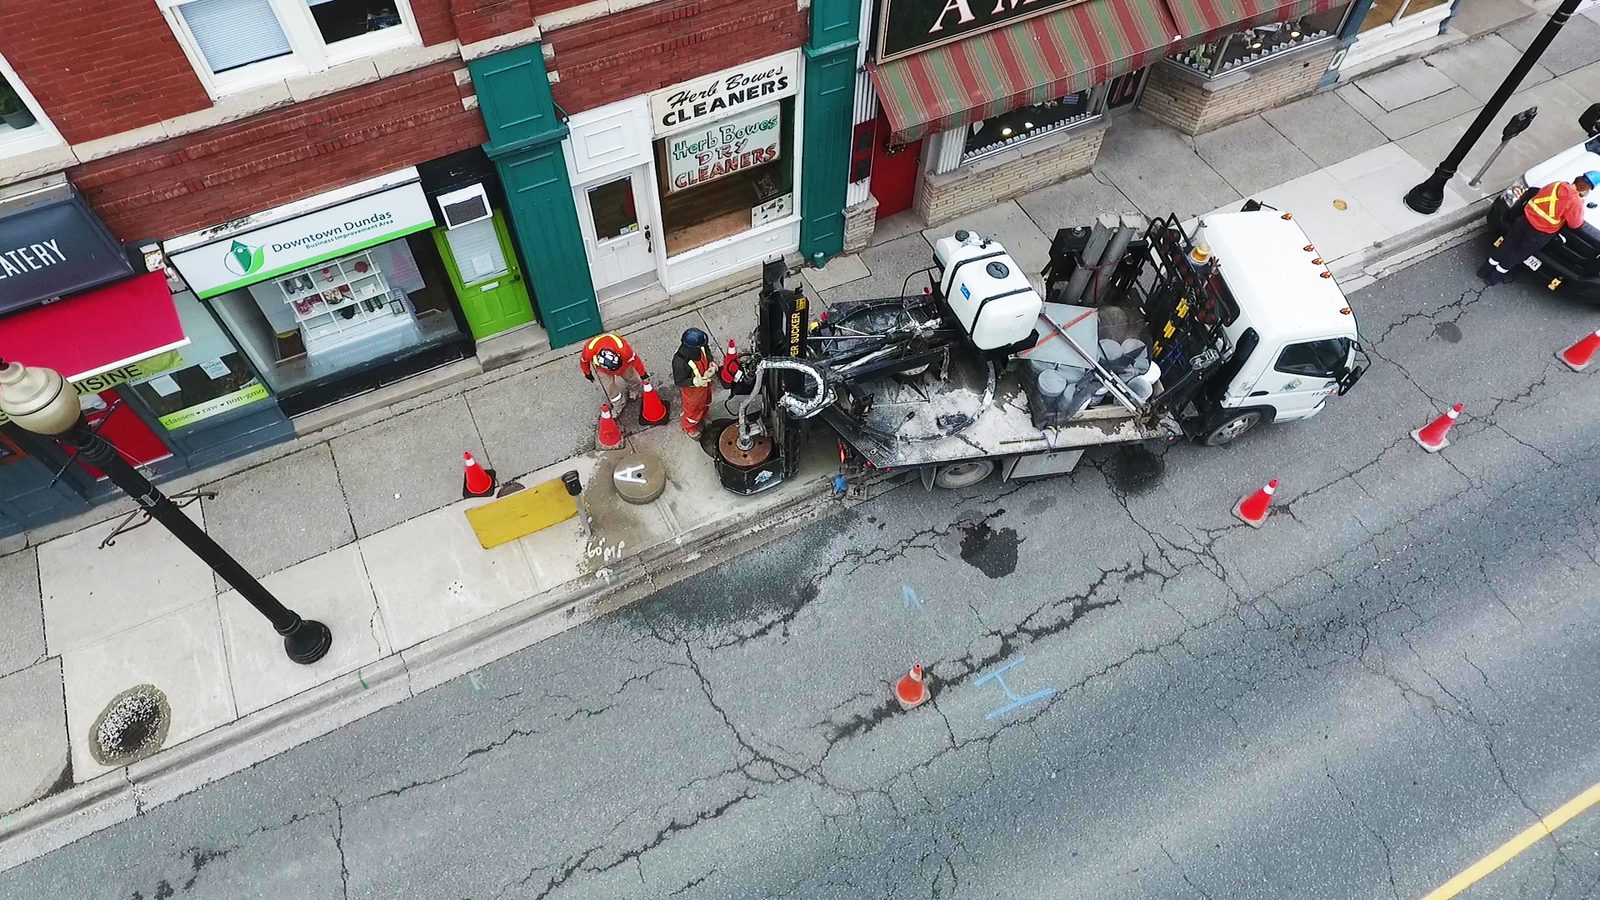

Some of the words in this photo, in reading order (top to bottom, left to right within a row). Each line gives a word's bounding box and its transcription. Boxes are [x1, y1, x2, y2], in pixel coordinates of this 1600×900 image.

[662, 76, 789, 127] CLEANERS
[667, 80, 720, 110] Herb
[725, 66, 784, 91] Bowes
[672, 131, 718, 161] Herb
[719, 114, 779, 145] Bowes
[695, 138, 749, 166] DRY
[674, 142, 778, 189] CLEANERS
[272, 227, 343, 253] Downtown
[344, 211, 393, 231] Dundas
[305, 237, 334, 250] Business
[335, 225, 379, 241] Improvement
[379, 219, 394, 228] Area
[790, 312, 801, 344] SUCKER
[164, 412, 196, 426] classes
[202, 404, 219, 414] raw
[226, 388, 265, 405] non-gmo
[614, 464, 647, 484] A
